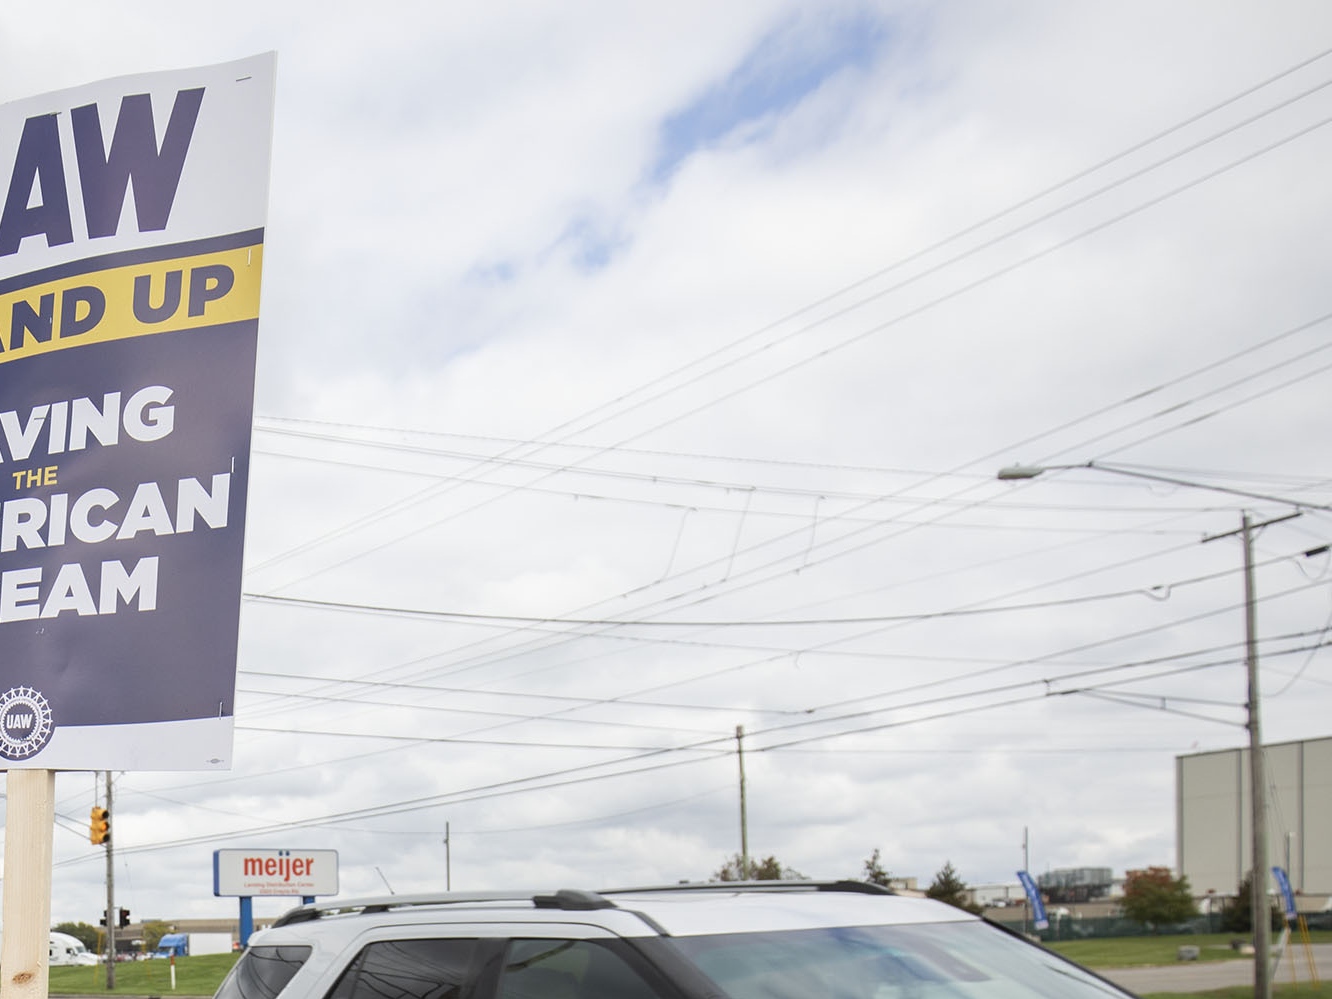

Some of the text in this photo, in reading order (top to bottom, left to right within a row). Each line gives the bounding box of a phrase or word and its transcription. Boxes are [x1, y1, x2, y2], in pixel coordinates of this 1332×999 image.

[132, 263, 235, 325] UP
[12, 465, 58, 490] THE
[6, 713, 33, 729] UAW
[244, 850, 314, 882] meijer
